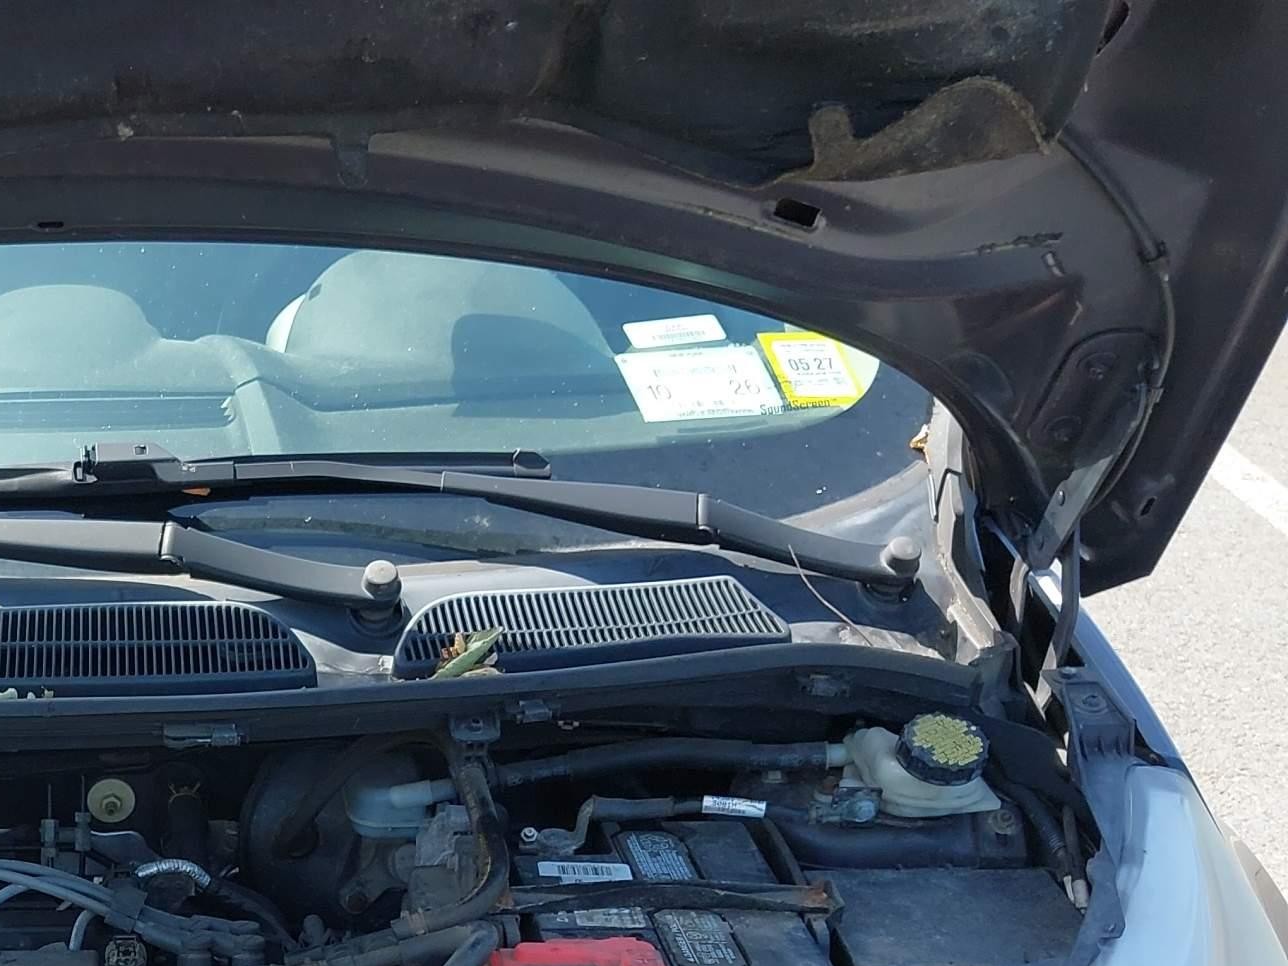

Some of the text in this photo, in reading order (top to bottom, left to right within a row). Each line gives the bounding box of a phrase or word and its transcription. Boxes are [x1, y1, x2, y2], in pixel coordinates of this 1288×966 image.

[788, 356, 834, 371] 05 27
[647, 378, 761, 400] 10 26
